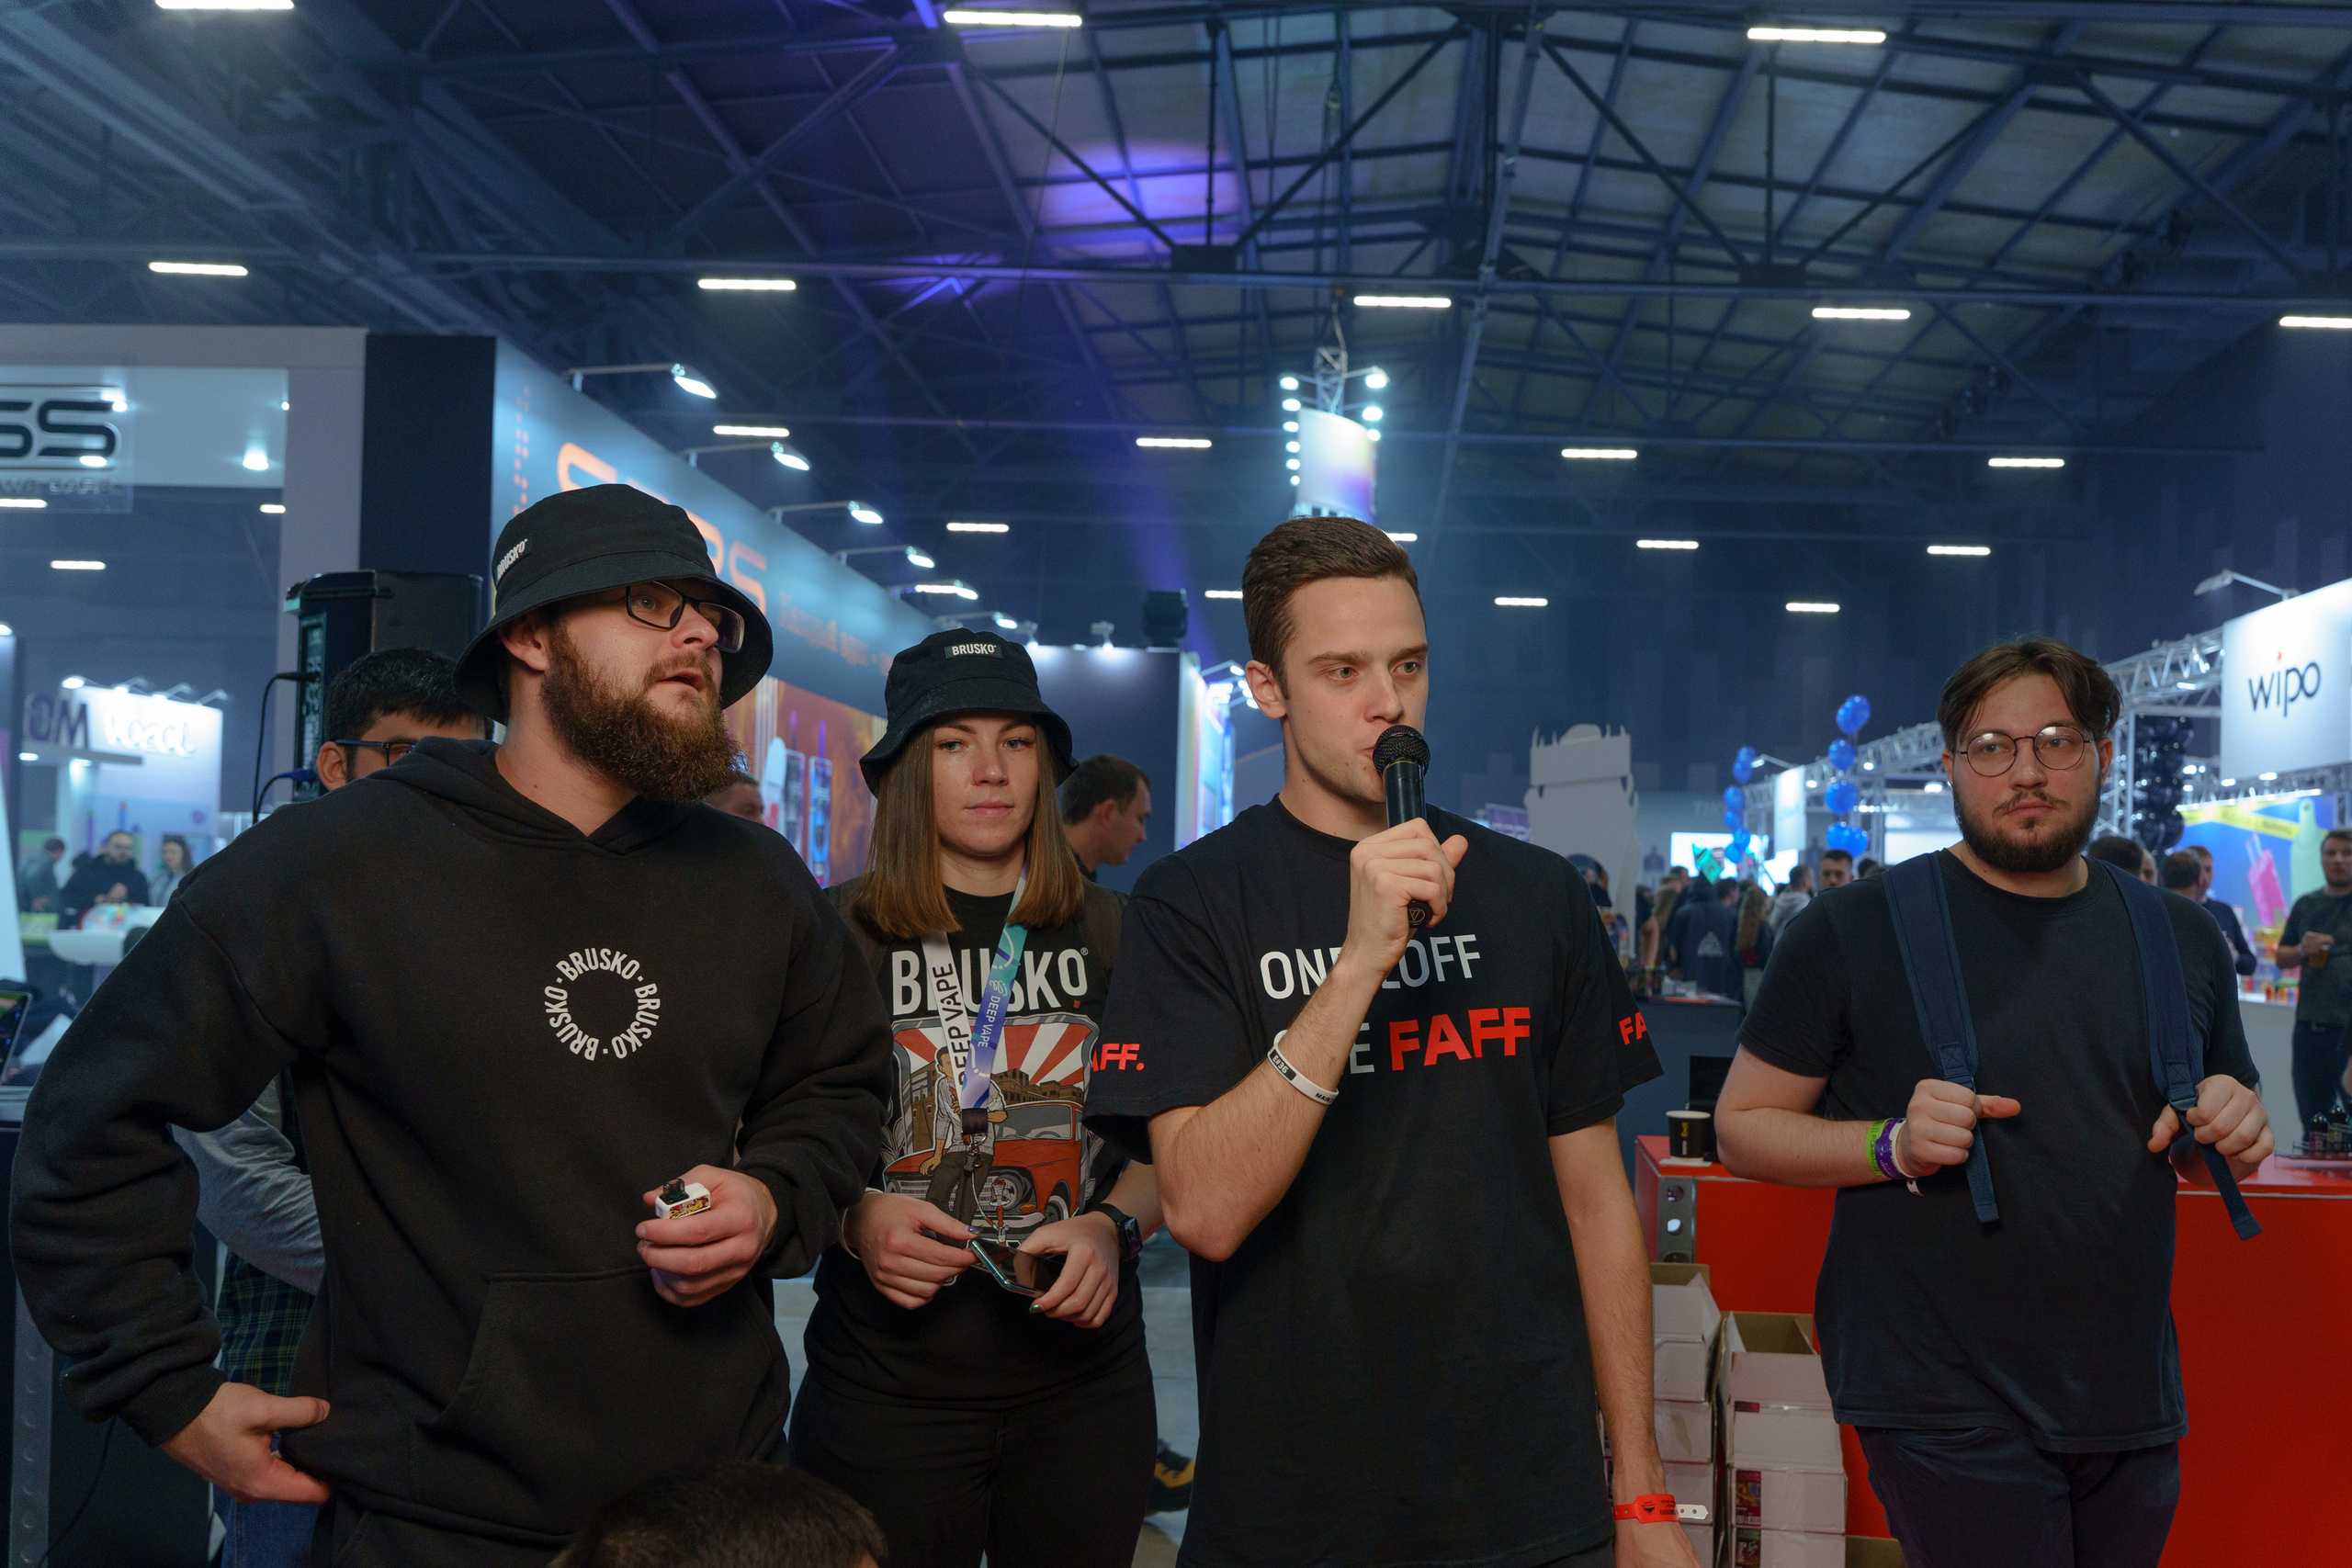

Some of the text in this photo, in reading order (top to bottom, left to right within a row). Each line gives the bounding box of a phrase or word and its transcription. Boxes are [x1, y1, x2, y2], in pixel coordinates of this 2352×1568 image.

[952, 643, 996, 656] BRUSKO
[2247, 650, 2323, 717] wipo
[544, 947, 661, 1061] BRUSKO BRUSKO BRUSKO
[933, 963, 964, 1021] VAPE
[977, 995, 1001, 1048] DEEP VAPE
[1388, 1007, 1532, 1072] FAFF
